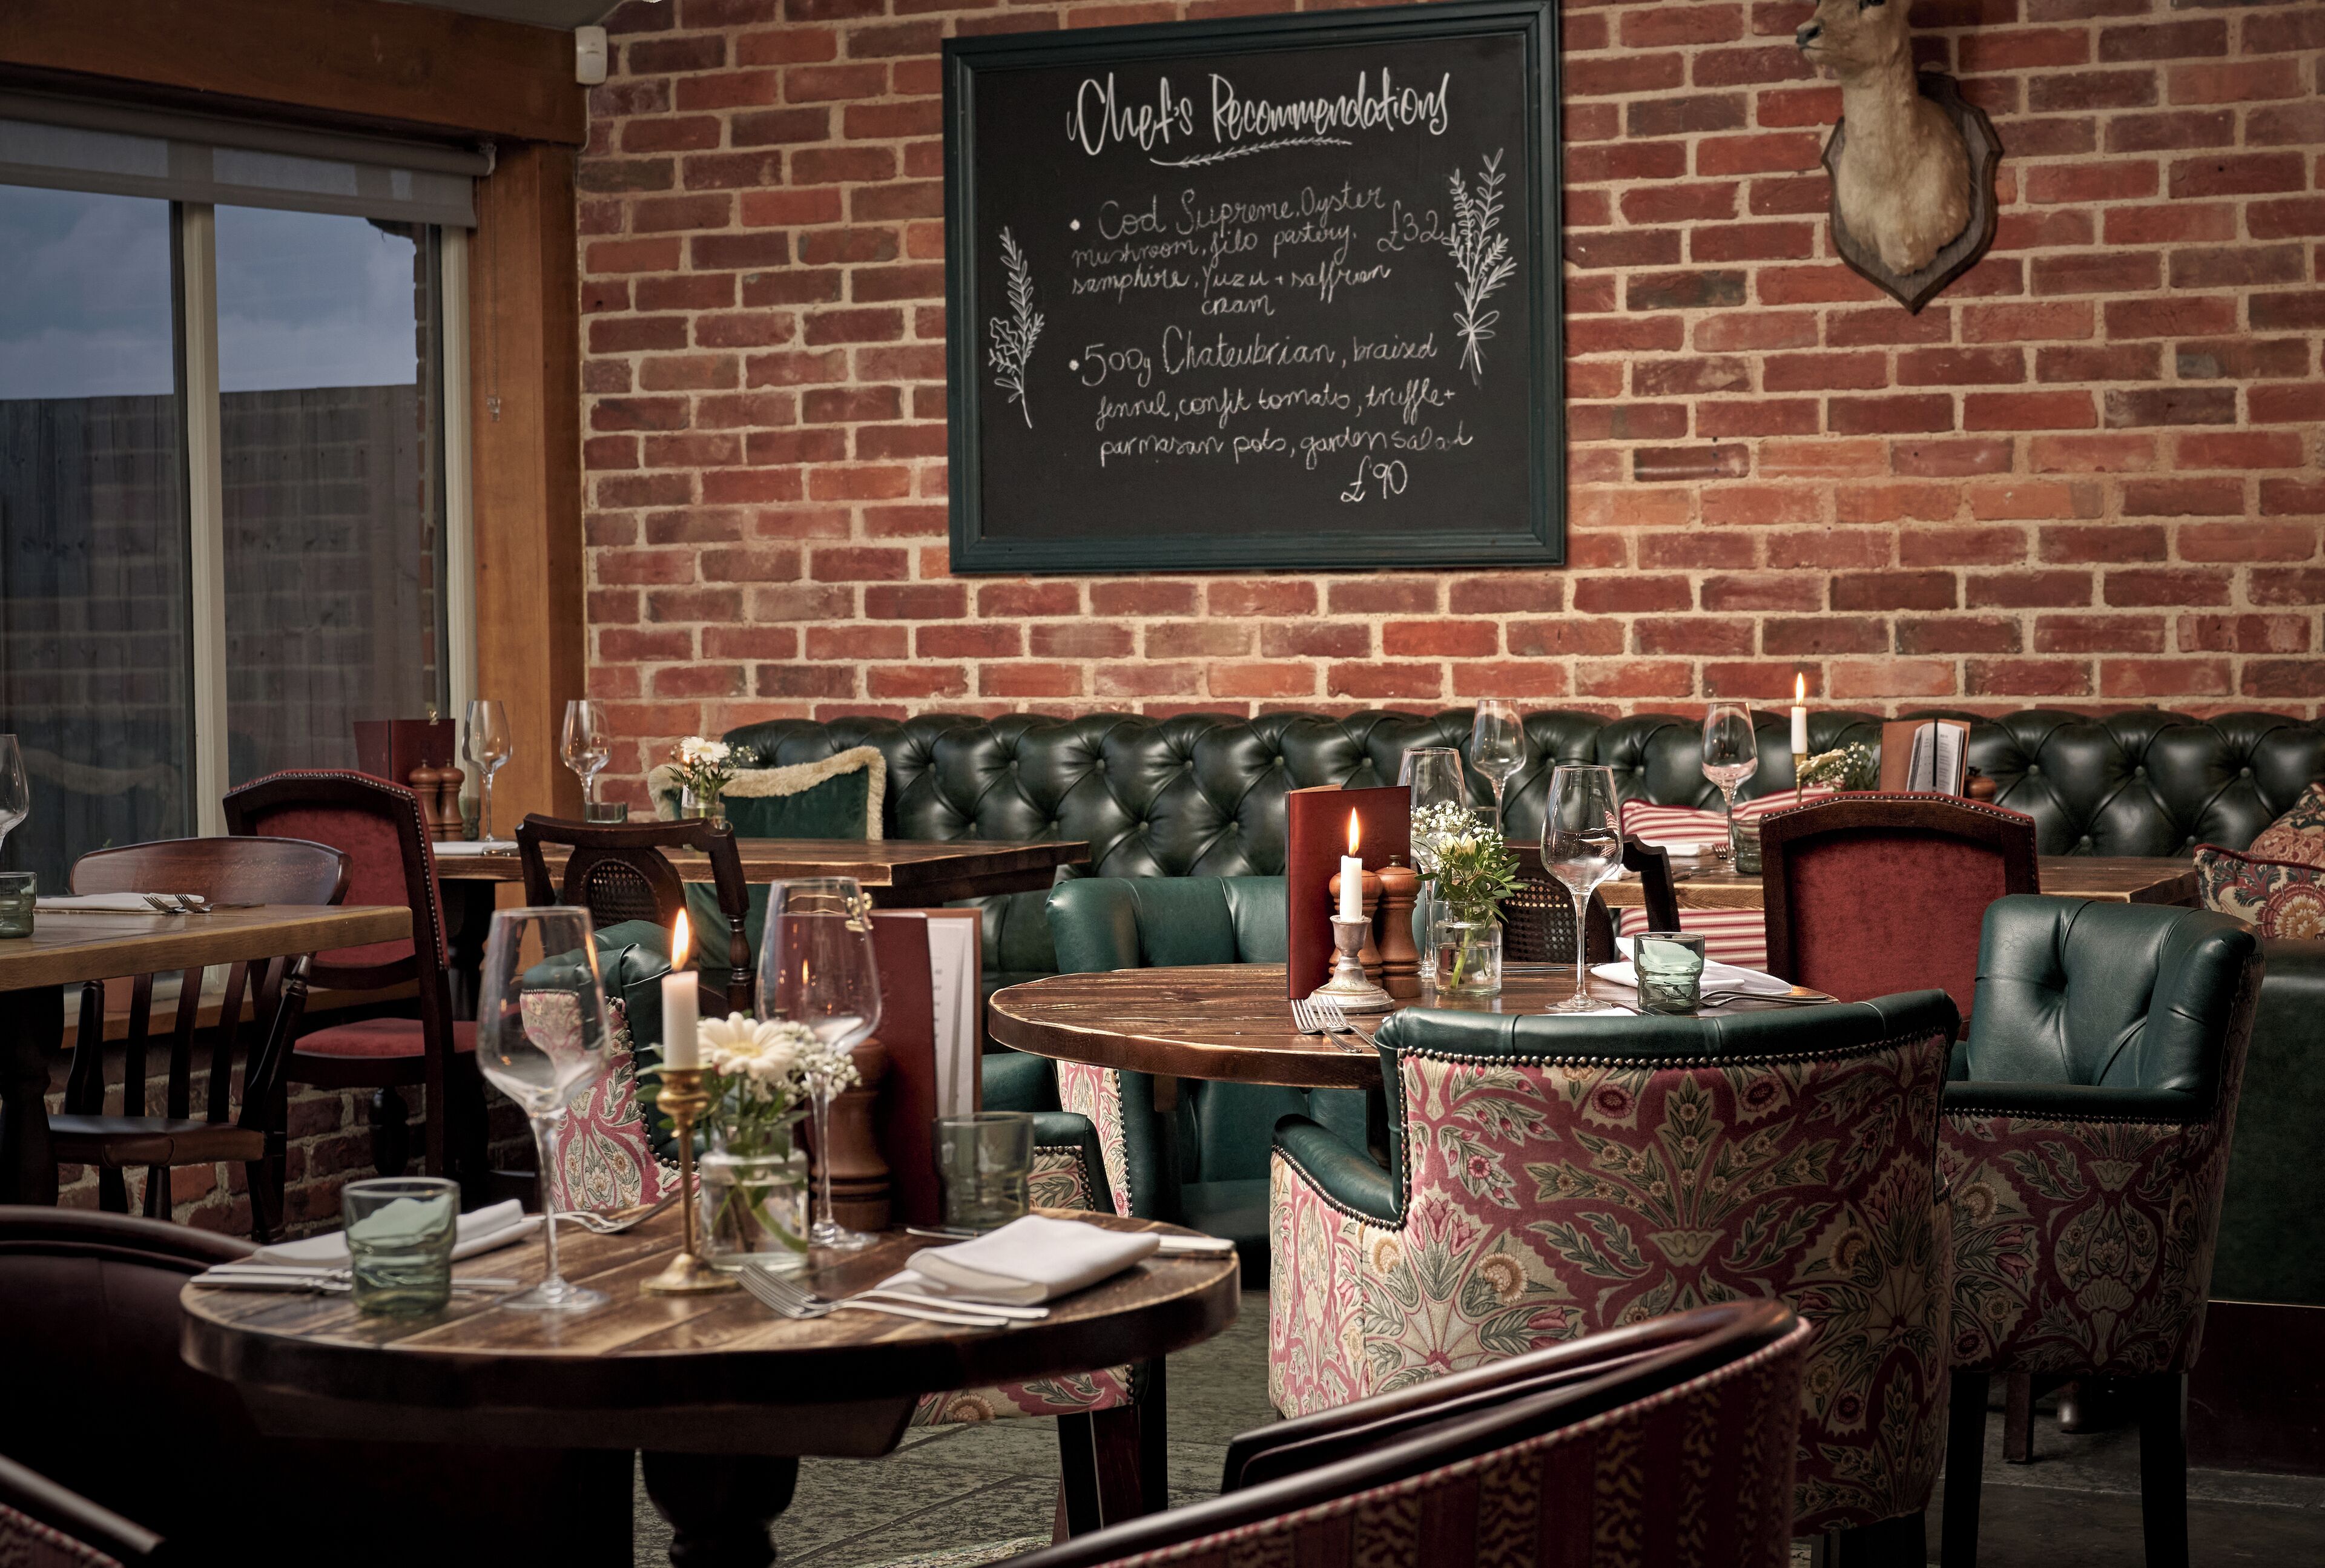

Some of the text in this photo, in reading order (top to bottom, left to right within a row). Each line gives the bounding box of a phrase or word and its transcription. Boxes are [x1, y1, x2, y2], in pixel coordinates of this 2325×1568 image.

[1066, 67, 1450, 156] Chef's Recommendations
[1098, 194, 1167, 240] Cod
[1301, 180, 1386, 228] Oyster
[1210, 228, 1258, 269] filo
[1376, 199, 1445, 251] £32
[1201, 294, 1276, 317] cream
[1081, 342, 1152, 388] 500g
[1353, 331, 1439, 363] braised
[1095, 390, 1179, 432] fennel,
[1179, 387, 1252, 430] confit
[1299, 425, 1388, 471] garden
[1390, 419, 1474, 452] salad
[1339, 454, 1408, 503] £90
